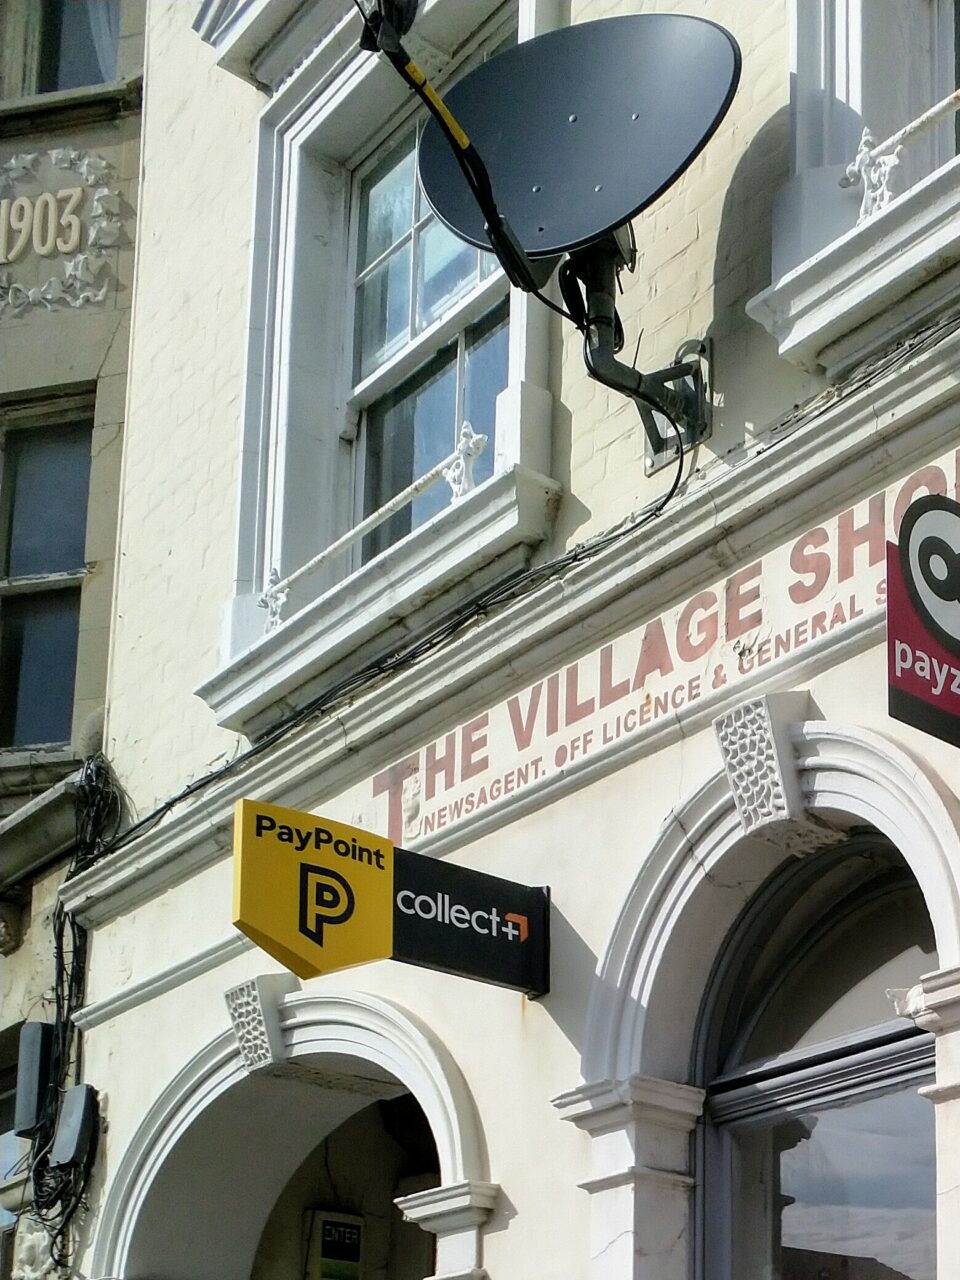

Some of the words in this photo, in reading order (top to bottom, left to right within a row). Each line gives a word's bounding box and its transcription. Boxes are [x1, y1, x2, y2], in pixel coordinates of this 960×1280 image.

[0, 187, 83, 264] 1903
[373, 712, 490, 848] THE
[506, 559, 763, 752] VILLAGE
[554, 729, 594, 768] OFF
[602, 674, 701, 746] LICENCE
[711, 663, 728, 690] &
[737, 594, 864, 675] GENERAL
[256, 814, 386, 871] PayPoint
